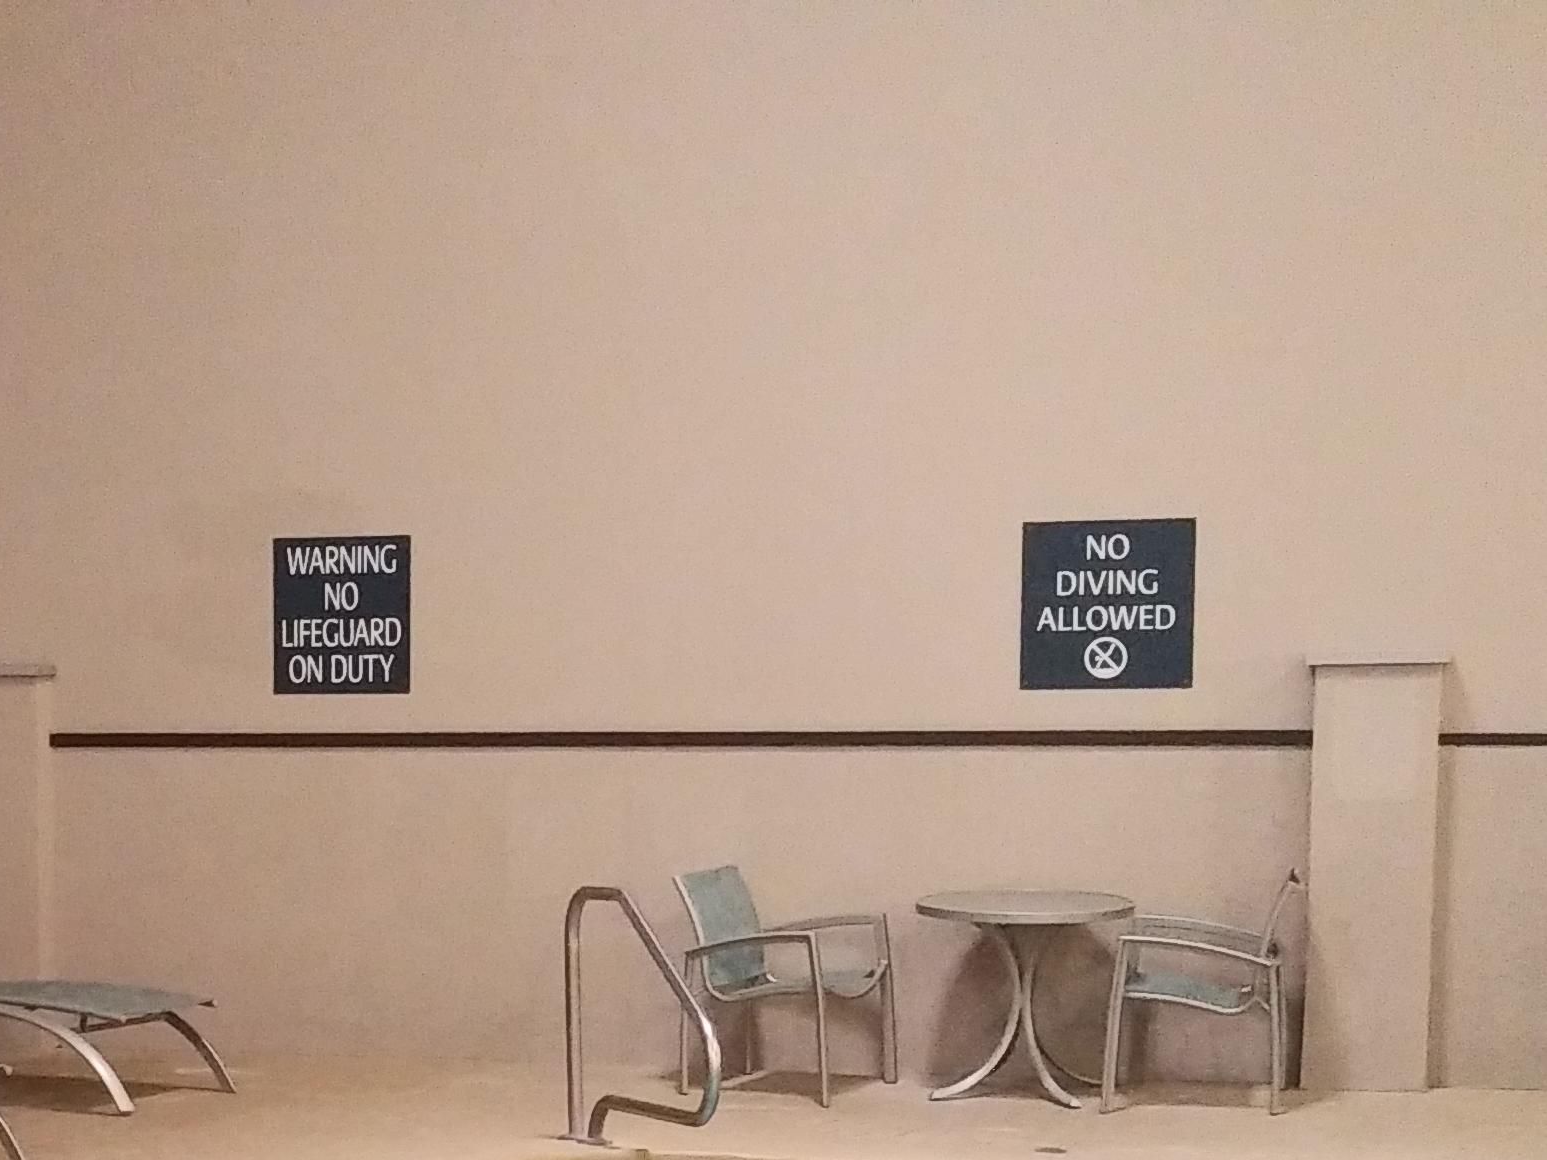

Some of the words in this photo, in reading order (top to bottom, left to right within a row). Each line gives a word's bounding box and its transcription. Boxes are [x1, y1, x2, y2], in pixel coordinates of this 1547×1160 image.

[286, 544, 397, 575] WARNING
[1085, 533, 1131, 561] NO
[324, 581, 359, 611] NO
[1055, 568, 1159, 597] DIVING
[281, 617, 402, 648] LIFEGUARD
[1036, 604, 1176, 632] ALLOWED
[288, 654, 323, 684] ON
[331, 653, 395, 683] DUTY
